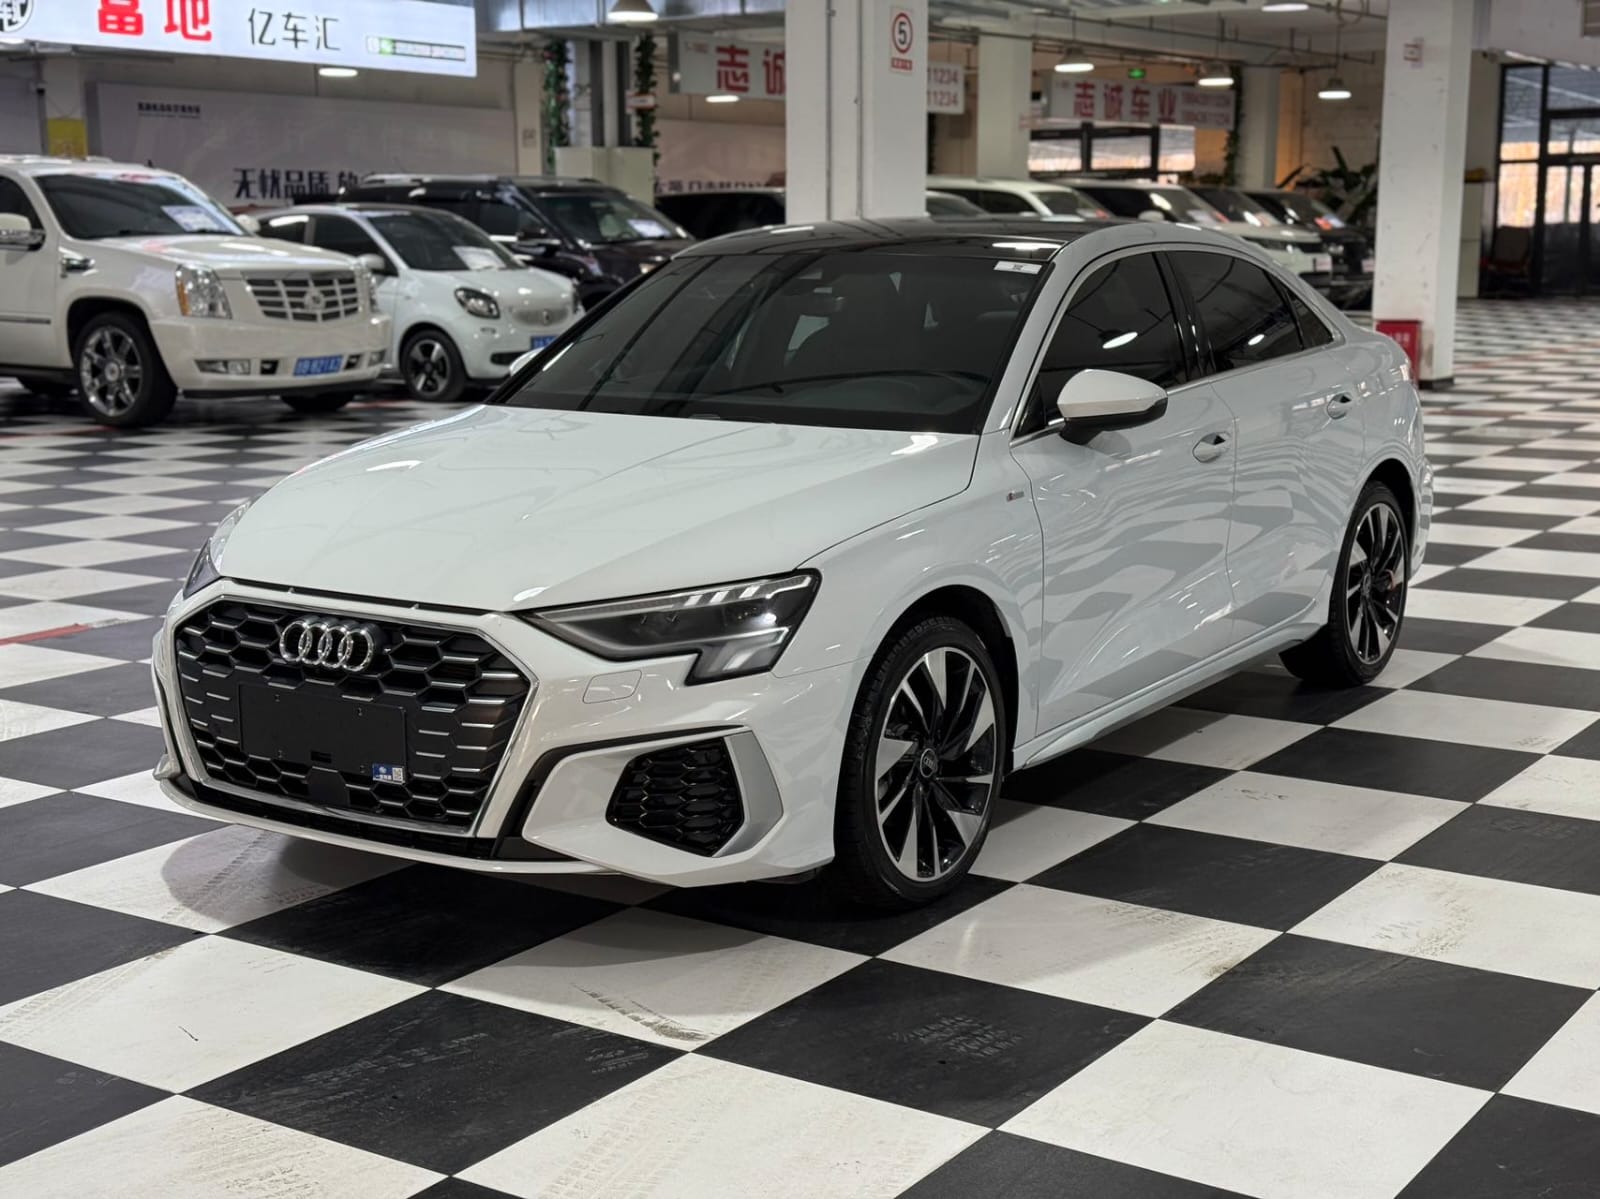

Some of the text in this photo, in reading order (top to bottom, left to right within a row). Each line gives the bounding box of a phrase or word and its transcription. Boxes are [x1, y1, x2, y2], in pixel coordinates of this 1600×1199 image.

[248, 8, 342, 51] 亿车汇
[898, 20, 908, 45] 5
[1074, 80, 1177, 123] 志诚车业
[233, 168, 329, 199] 无忧品质
